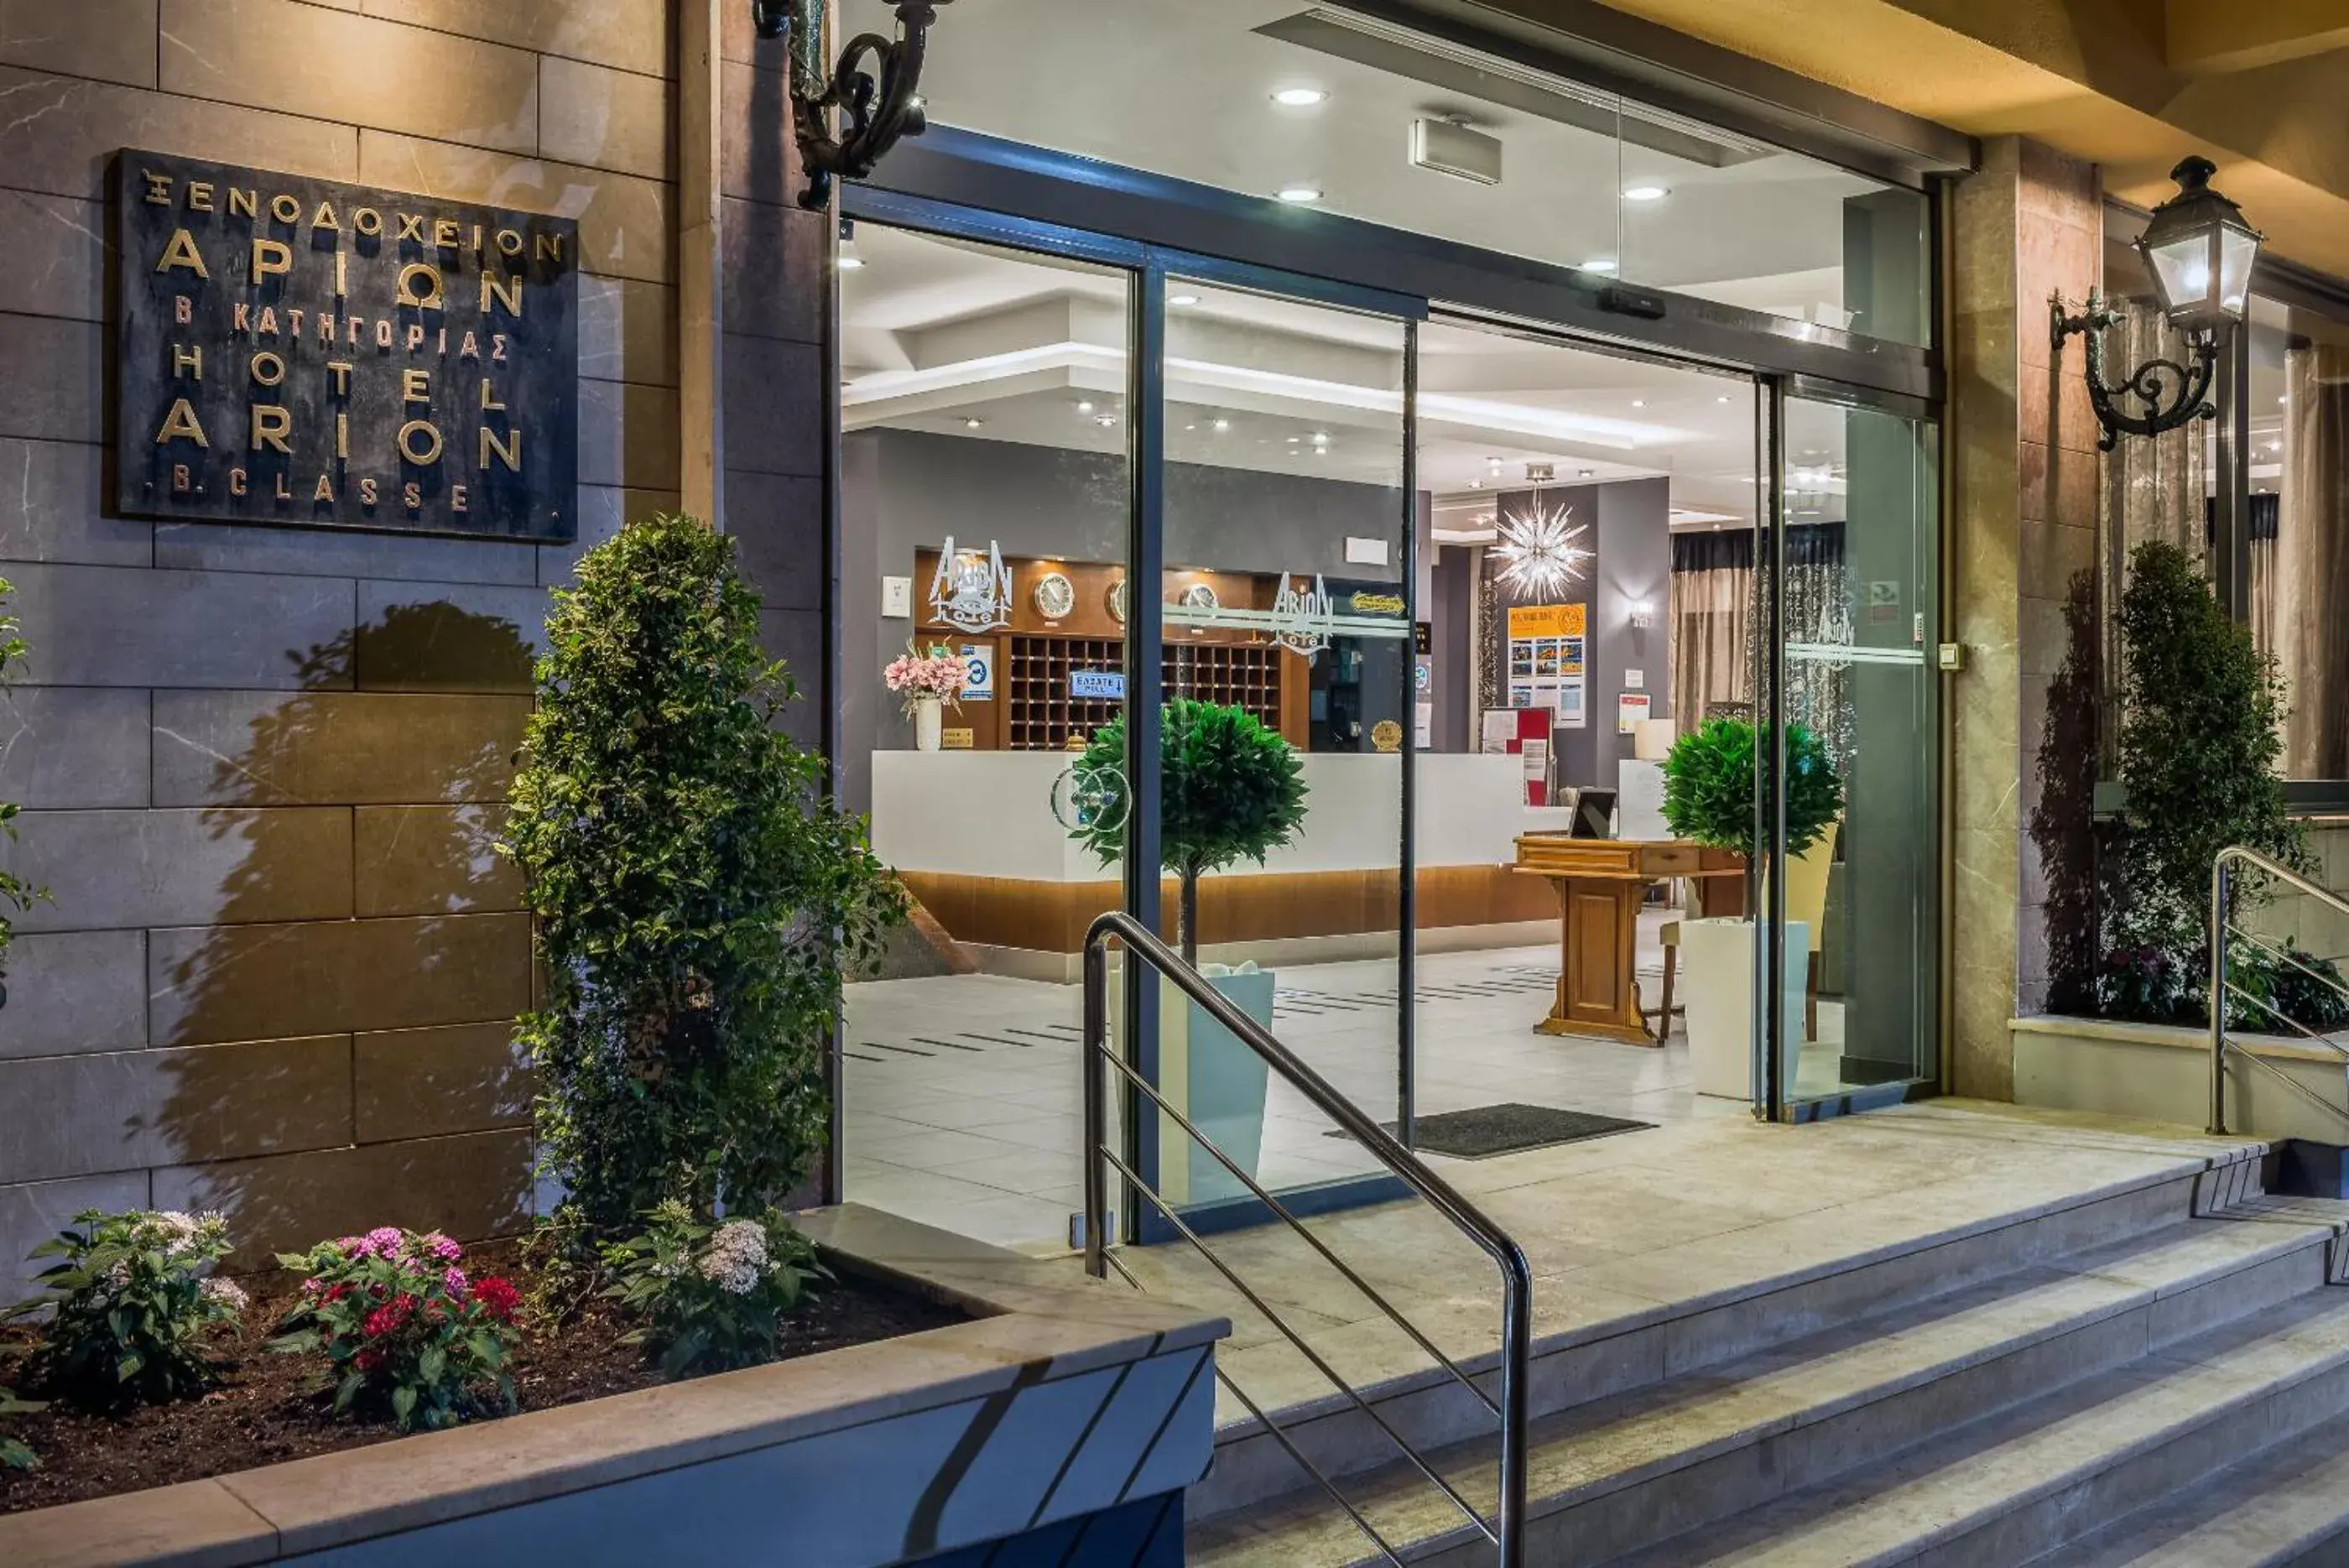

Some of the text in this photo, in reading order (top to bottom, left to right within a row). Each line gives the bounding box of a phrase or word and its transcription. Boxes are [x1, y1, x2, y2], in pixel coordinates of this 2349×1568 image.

[146, 174, 562, 262] ΞΕΝΟΔΟΧΕΙΟΝ
[156, 227, 523, 318] ΑΡΙΩΝ
[234, 302, 508, 361] ΚΑΤΗΓΟΡΙΑΣ
[172, 343, 506, 410] HOTEL
[156, 398, 522, 472] ARION
